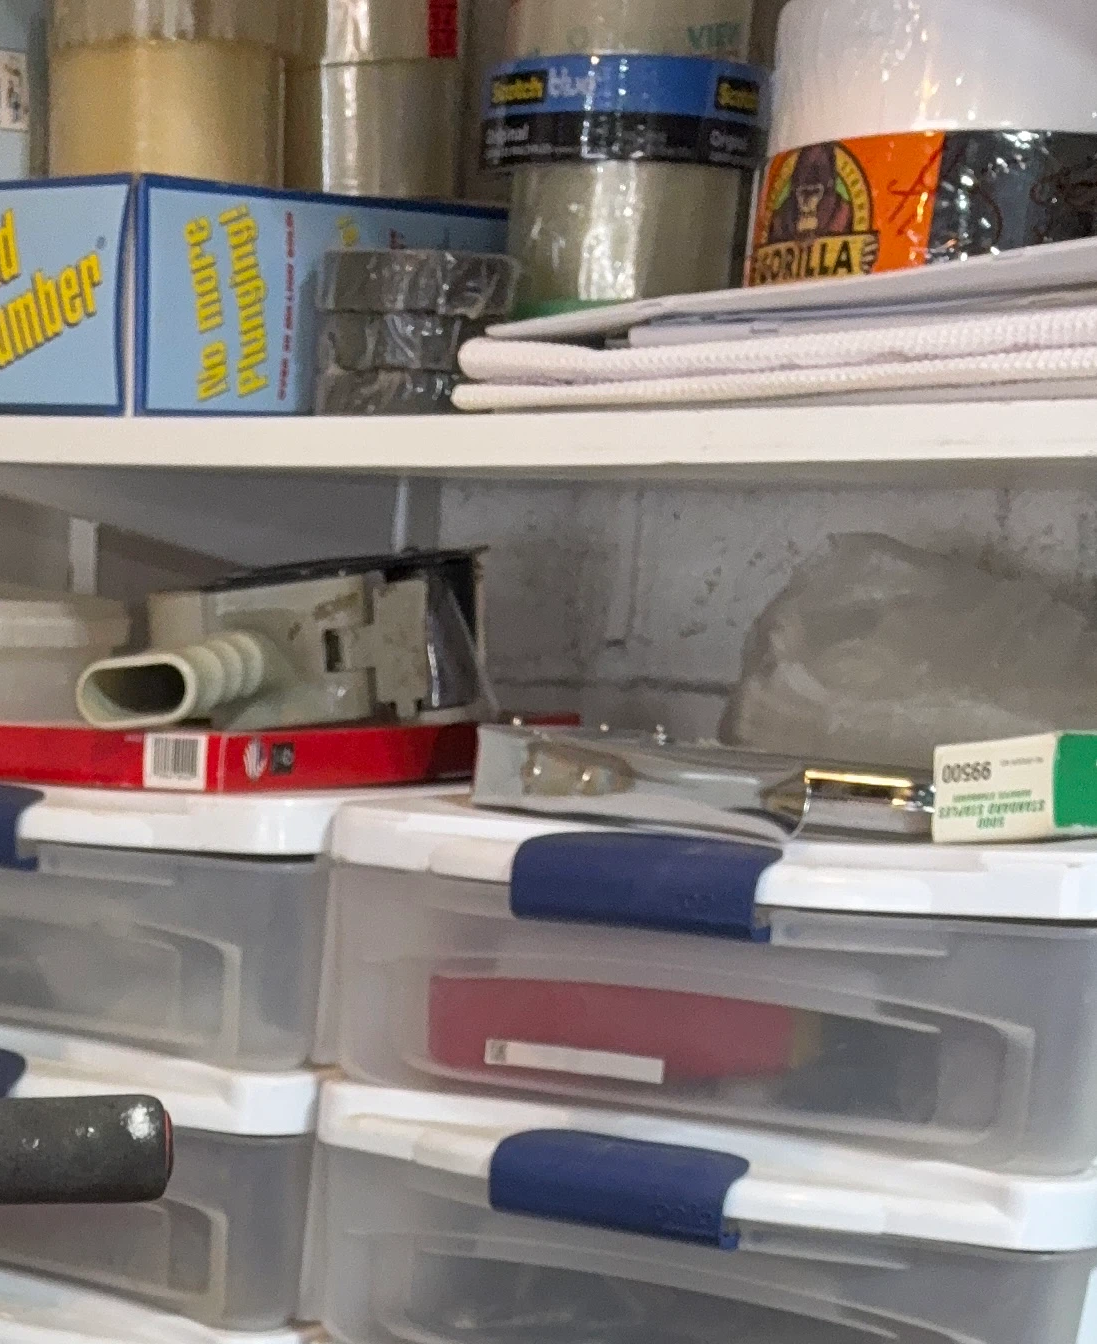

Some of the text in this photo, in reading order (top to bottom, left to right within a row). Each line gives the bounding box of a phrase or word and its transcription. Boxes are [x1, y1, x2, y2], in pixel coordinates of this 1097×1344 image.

[183, 215, 229, 402] No more
[217, 203, 269, 398] Plunging!
[941, 760, 993, 784] 99500
[987, 799, 1046, 815] STANDARD
